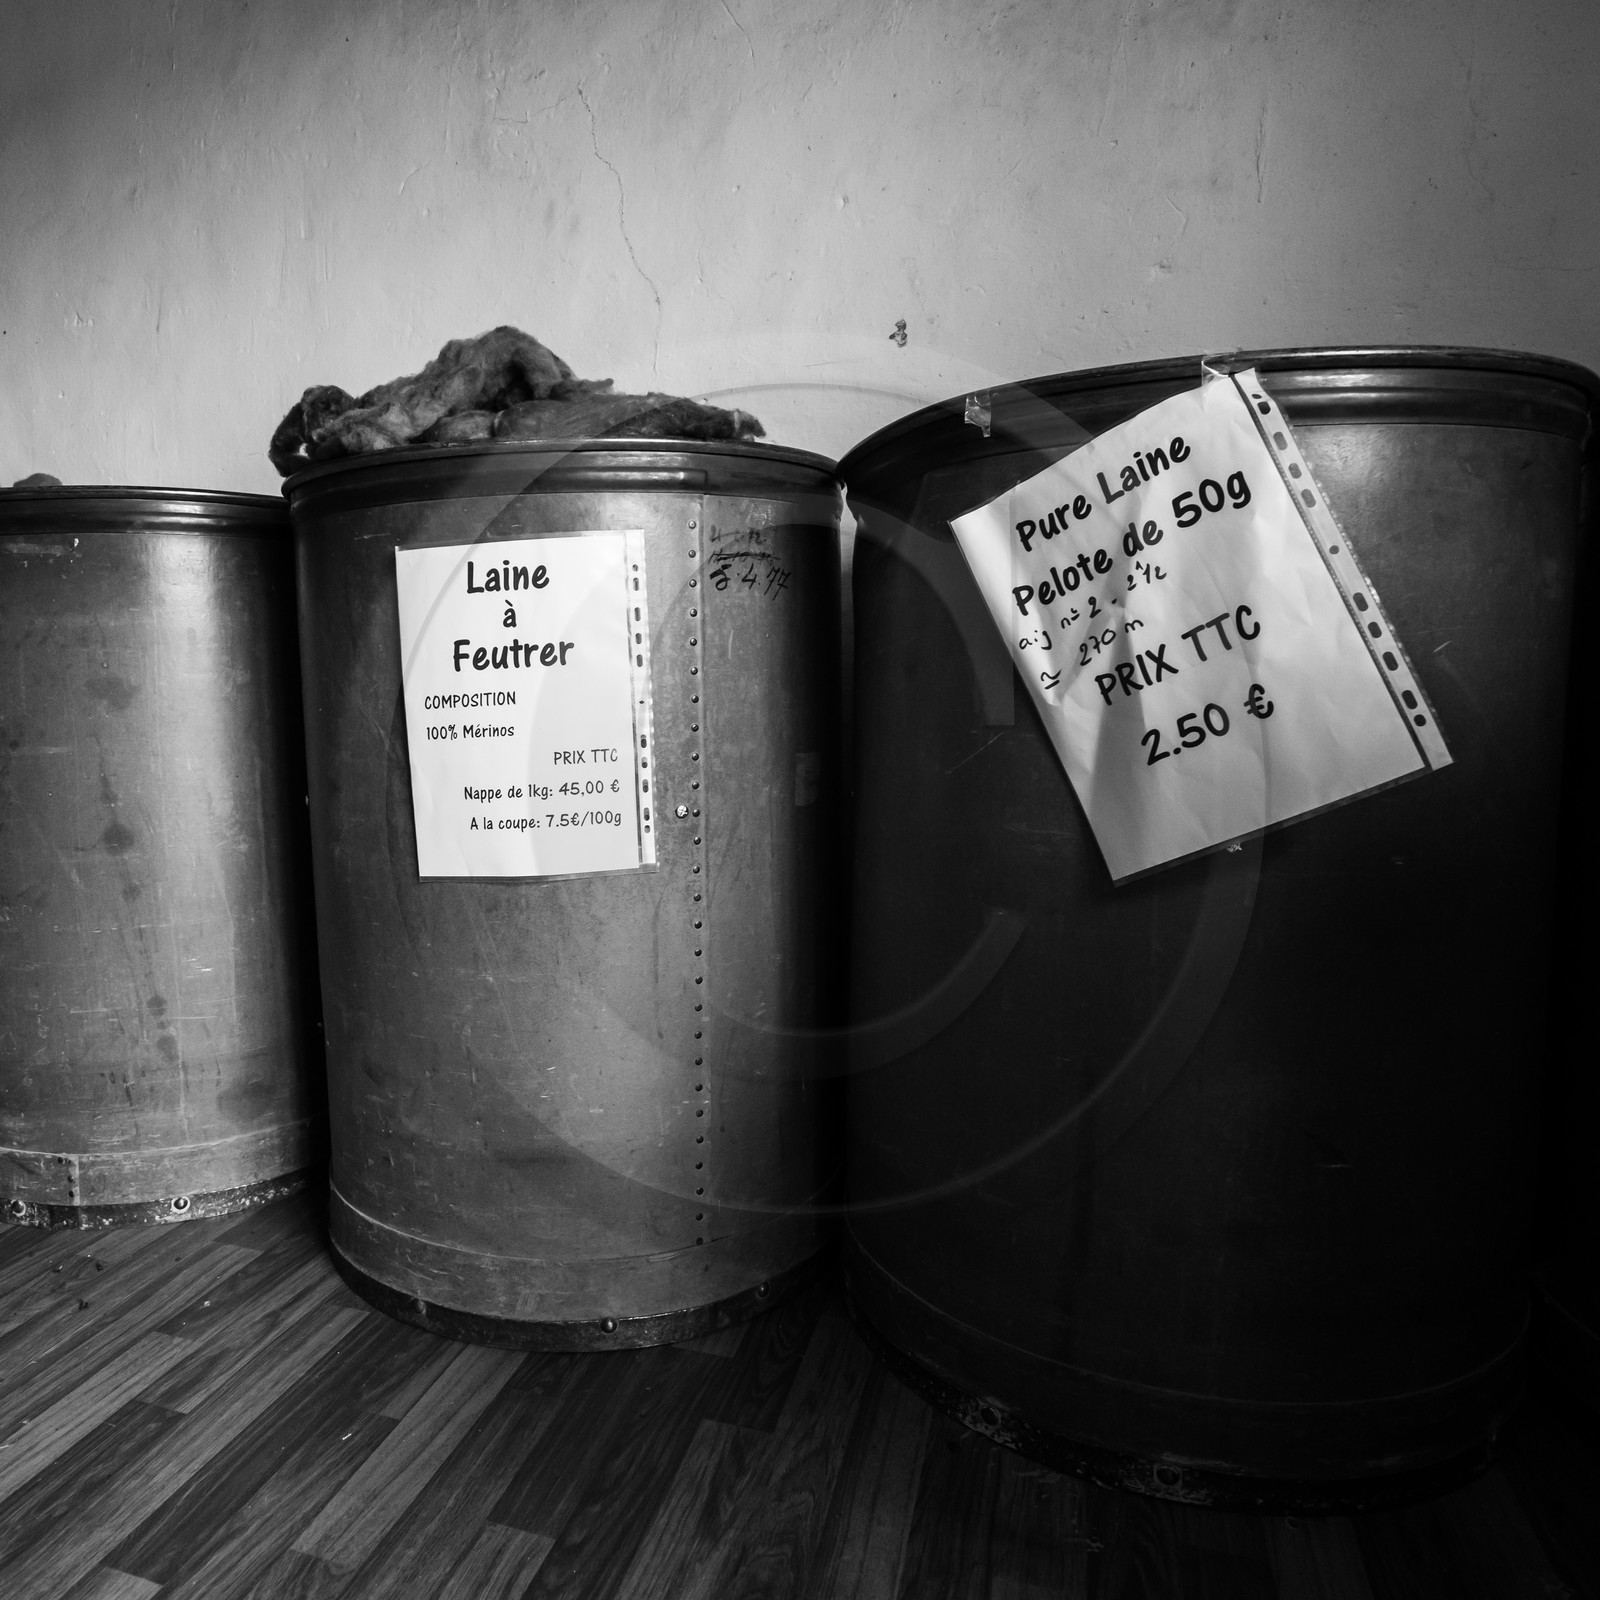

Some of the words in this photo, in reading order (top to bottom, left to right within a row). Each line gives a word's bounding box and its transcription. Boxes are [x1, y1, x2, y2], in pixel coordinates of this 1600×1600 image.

[1015, 494, 1093, 553] Pure
[1095, 436, 1192, 505] Laine
[1011, 548, 1114, 617] Pelote
[1122, 519, 1164, 558] de
[1171, 470, 1252, 529] 50g
[466, 559, 550, 595] Laine
[502, 599, 518, 629] à
[452, 638, 575, 673] Feutrer
[1094, 643, 1180, 707] PRIX
[1180, 604, 1261, 663] TTC
[424, 690, 517, 710] COMPOSITION
[426, 723, 458, 741] 100%
[462, 723, 515, 739] Mérinos
[1140, 702, 1231, 767] 2.50
[1243, 682, 1275, 720] €
[553, 749, 586, 766] PRIX
[590, 748, 618, 763] TTC
[464, 786, 503, 804] Nappe
[507, 785, 524, 799] de
[527, 783, 553, 801] 1kg:
[558, 780, 604, 796] 45,00
[610, 778, 620, 793] €
[470, 816, 479, 831] A
[483, 816, 494, 830] la
[498, 818, 541, 833] coupe:
[545, 810, 622, 828] 7.5€/100g
